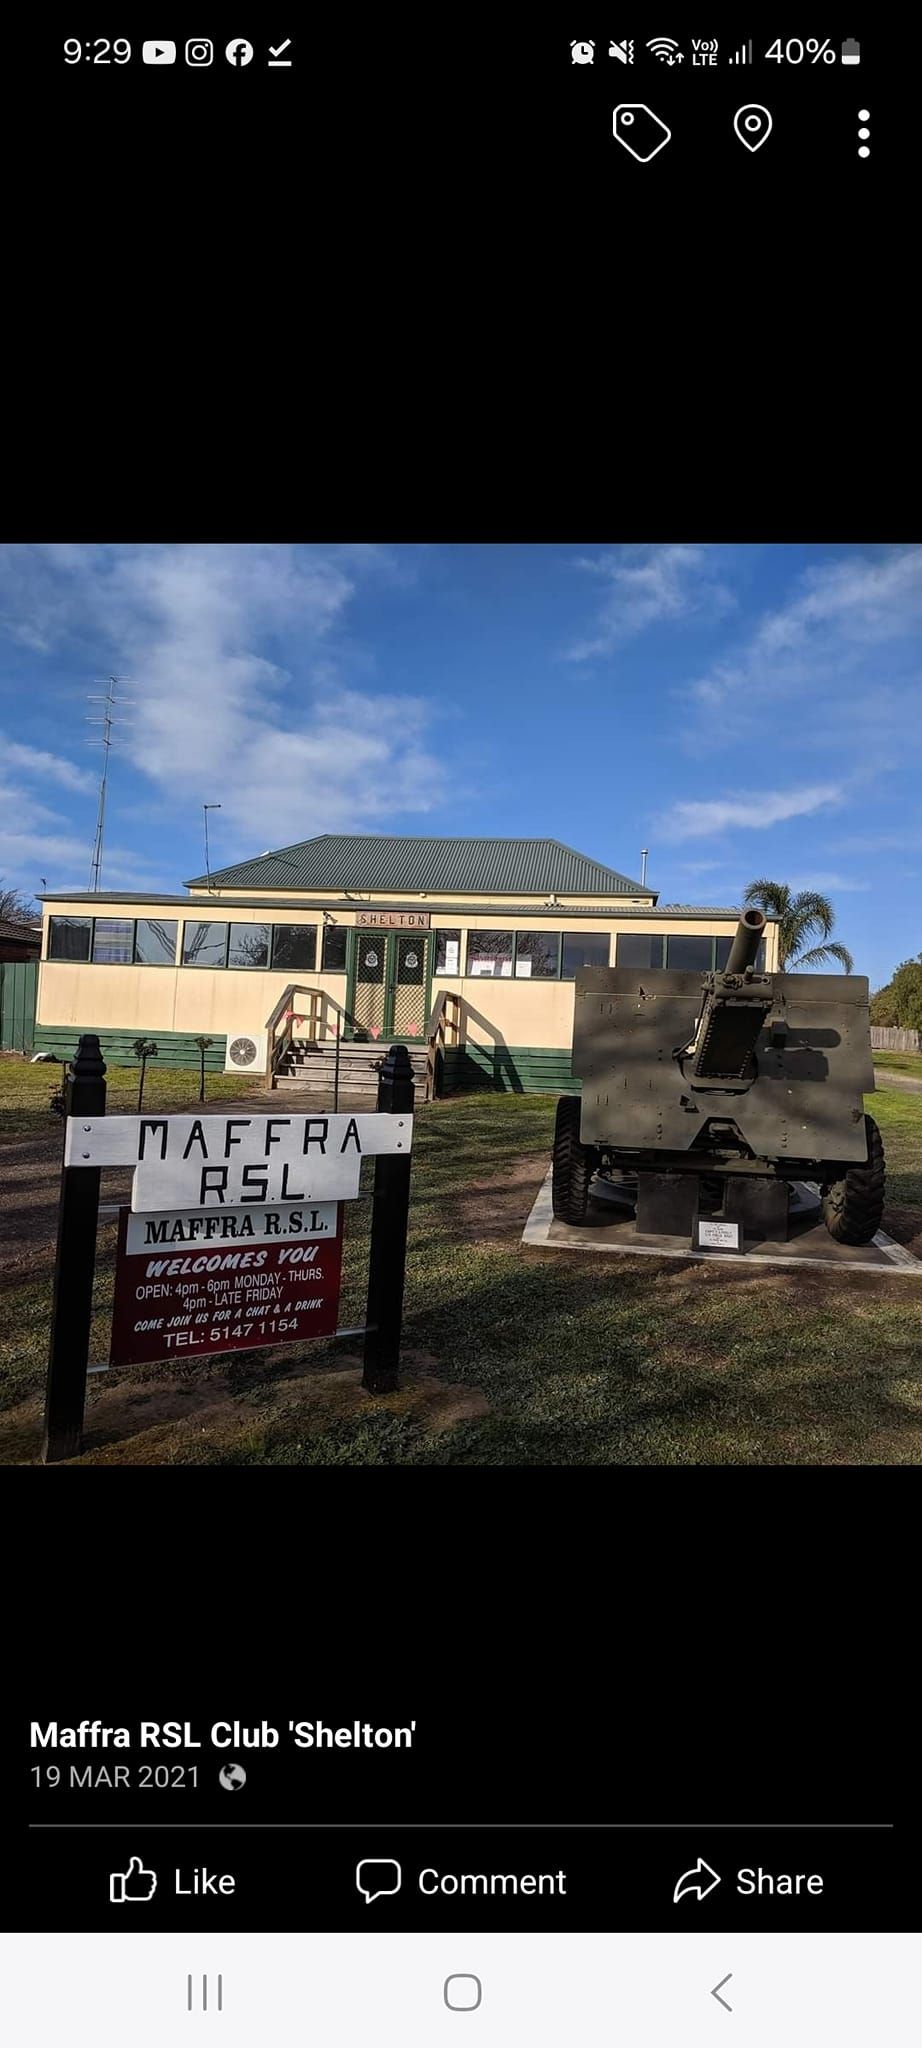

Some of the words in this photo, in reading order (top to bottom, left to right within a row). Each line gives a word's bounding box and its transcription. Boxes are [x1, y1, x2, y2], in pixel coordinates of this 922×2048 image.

[359, 914, 425, 925] SHELTON
[138, 1118, 362, 1160] MAFFRA
[200, 1163, 311, 1205] R.S.L.
[144, 1217, 256, 1245] MAFFRA
[264, 1211, 328, 1236] R.S.L.
[145, 1251, 268, 1278] WELCOMES
[278, 1246, 319, 1265] YOU
[135, 1284, 173, 1300] OPEN:
[175, 1282, 199, 1299] 4pm
[207, 1279, 230, 1295] 6pm
[234, 1273, 282, 1291] MONDAY
[288, 1268, 325, 1281] THURS.
[182, 1295, 207, 1312] 4pm
[214, 1291, 242, 1307] LATE
[245, 1286, 284, 1302] FRIDAY
[134, 1318, 164, 1332] COME
[166, 1314, 192, 1328] JOIN
[195, 1312, 209, 1324] US
[212, 1309, 232, 1321] FOR
[234, 1307, 243, 1318] A
[245, 1303, 271, 1317] CHAT
[273, 1302, 281, 1313] &
[284, 1301, 292, 1312] A
[295, 1298, 324, 1311] DRINK
[163, 1331, 206, 1349] TEL:
[209, 1324, 253, 1342] 5147
[258, 1318, 299, 1336] 1154
